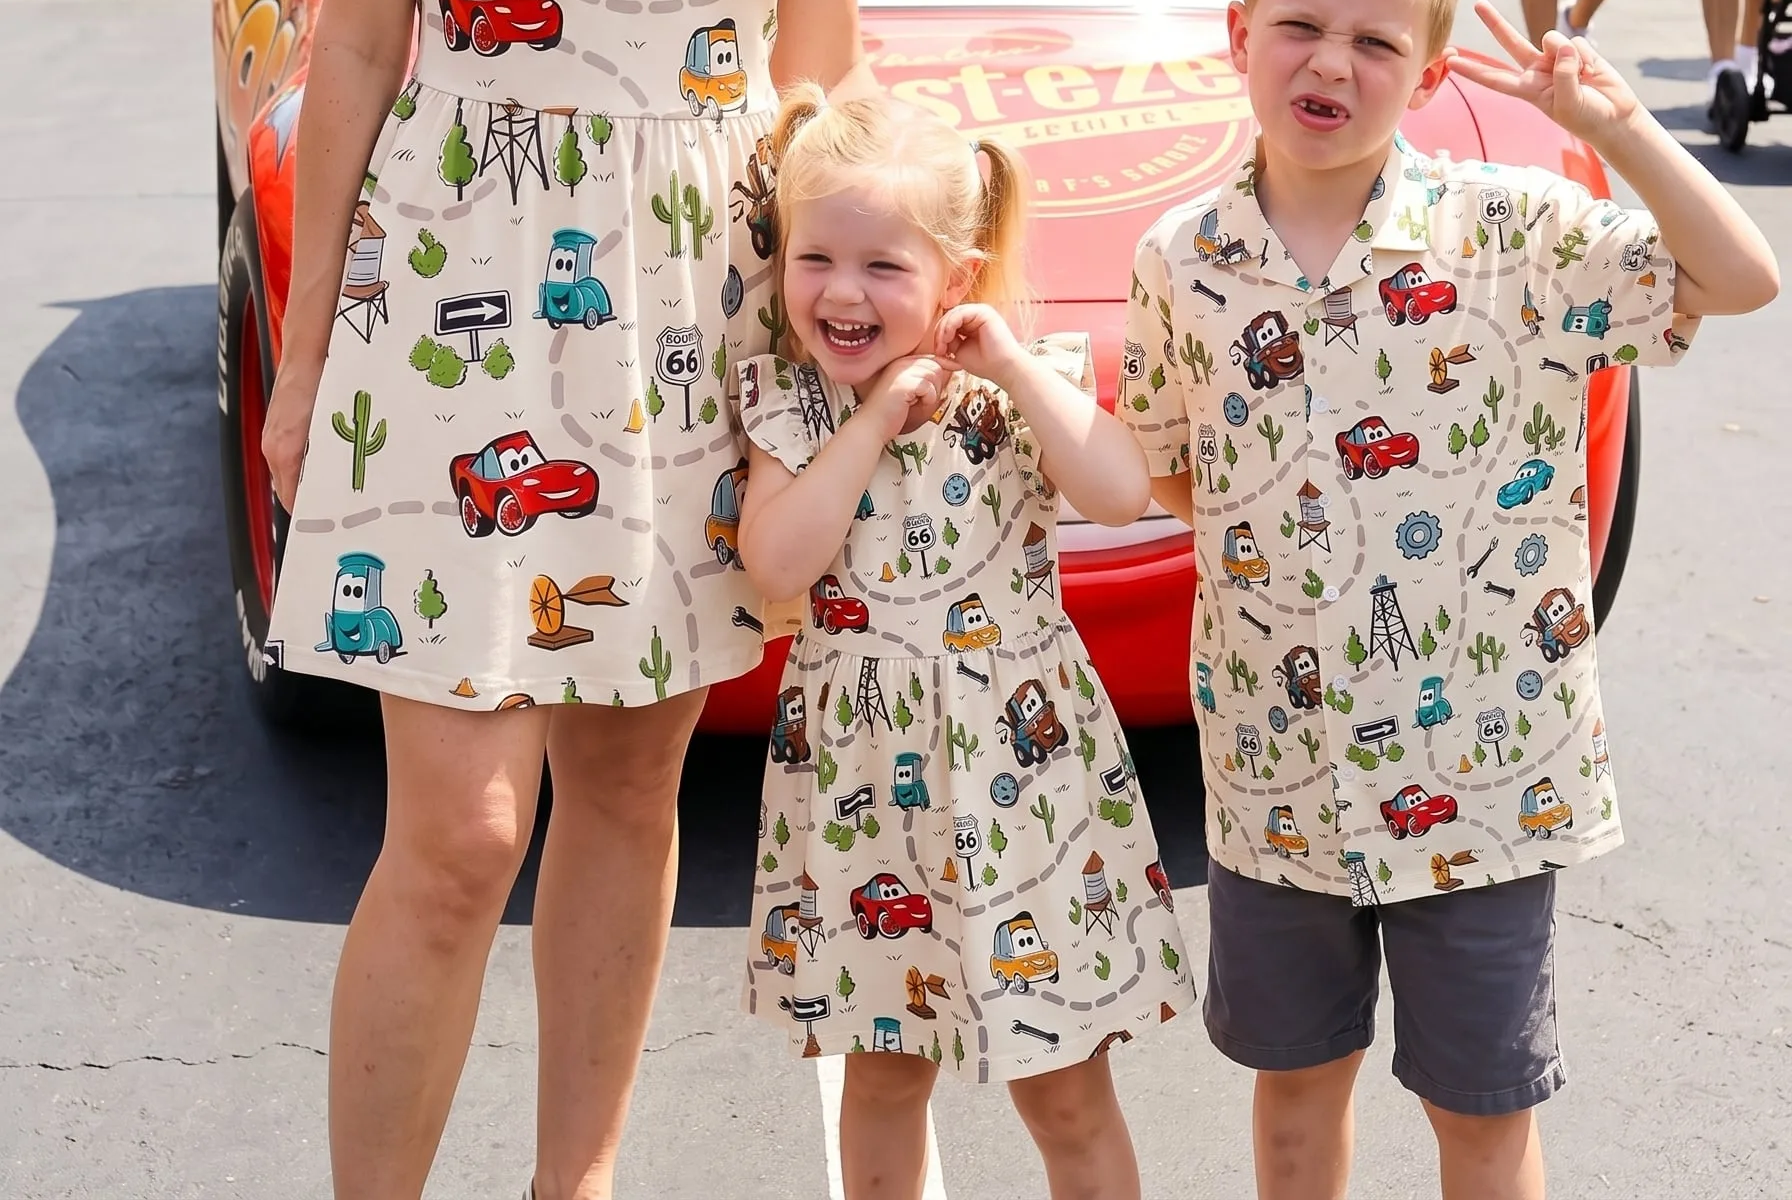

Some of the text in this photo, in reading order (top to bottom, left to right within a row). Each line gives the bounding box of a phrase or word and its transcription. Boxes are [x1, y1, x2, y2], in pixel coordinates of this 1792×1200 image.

[1486, 200, 1507, 217] 66
[666, 349, 698, 375] 66
[1200, 440, 1215, 457] 66
[908, 528, 931, 546] 66
[1483, 720, 1504, 737] 66
[1241, 736, 1257, 750] 66
[955, 831, 977, 850] 66
